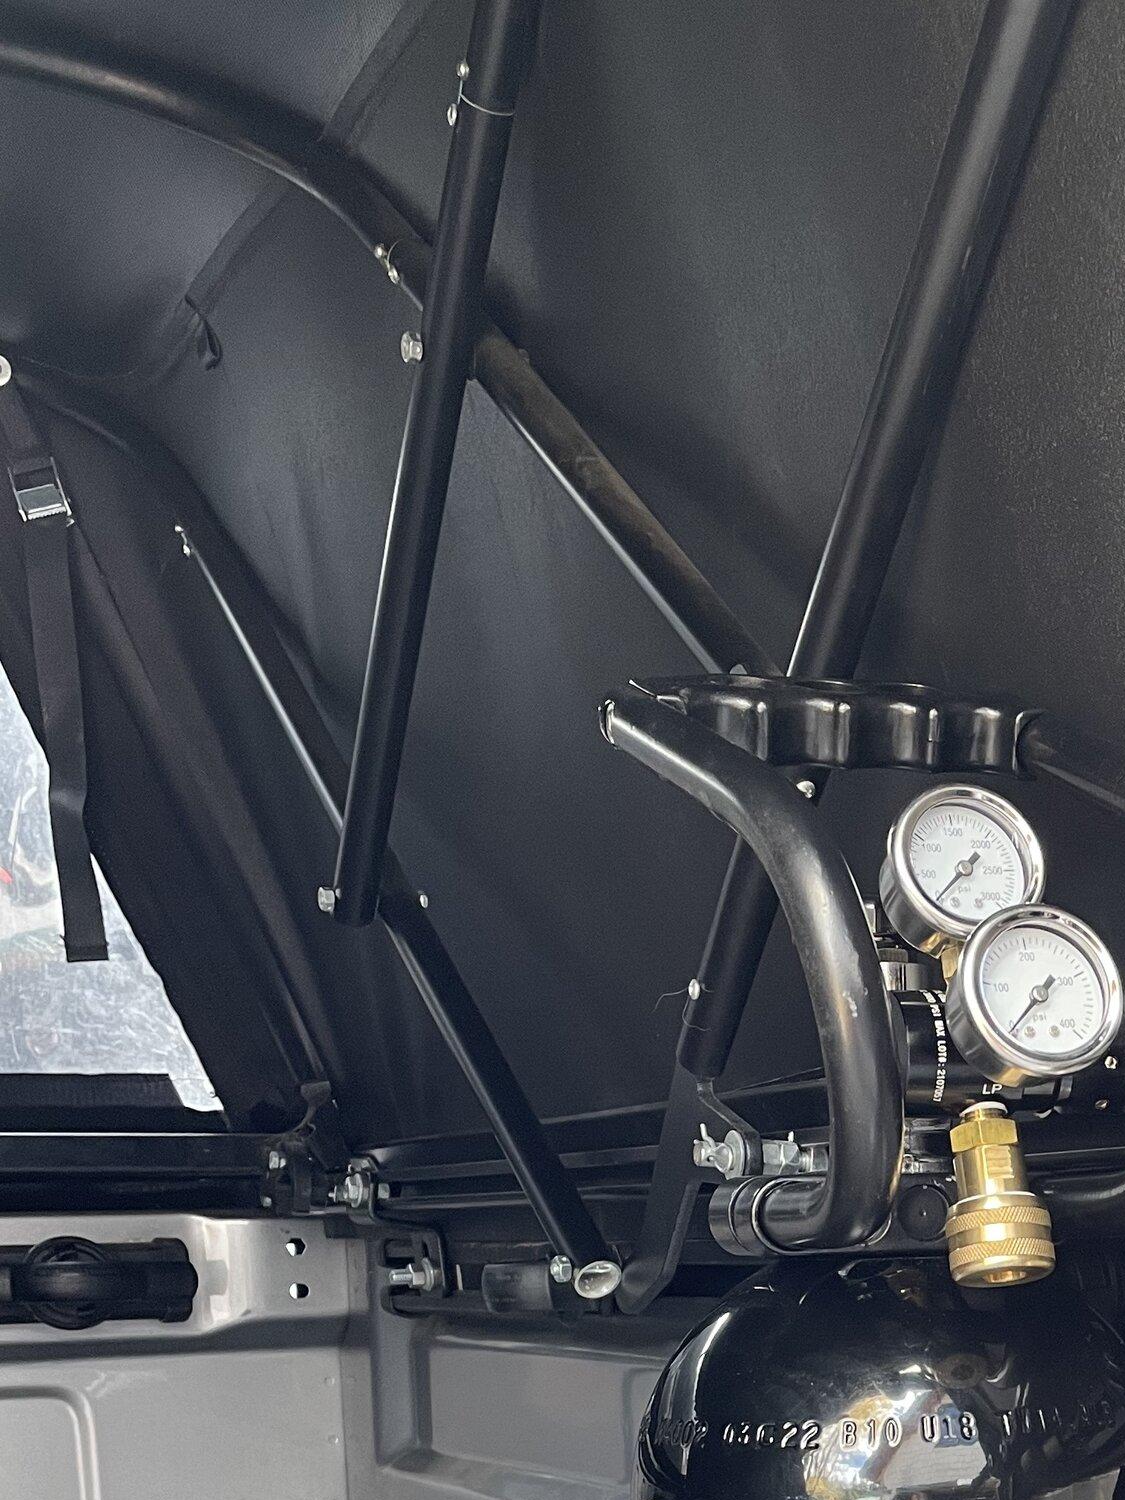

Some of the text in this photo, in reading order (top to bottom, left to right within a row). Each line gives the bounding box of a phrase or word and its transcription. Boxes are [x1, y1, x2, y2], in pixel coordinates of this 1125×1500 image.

[944, 827, 963, 838] 1500
[922, 843, 942, 853] 1000
[971, 840, 991, 850] 2000
[921, 870, 936, 879] 500
[983, 866, 1003, 875] 2500
[959, 884, 971, 894] psi
[981, 892, 1000, 901] 3000
[1019, 952, 1035, 962] 200
[1058, 976, 1074, 987] 300
[994, 982, 1009, 993] 100
[1033, 1012, 1047, 1023] psi
[1060, 1019, 1075, 1029] 400
[983, 1084, 1002, 1095] LP
[840, 1416, 901, 1451] B10
[921, 1410, 977, 1444] U18
